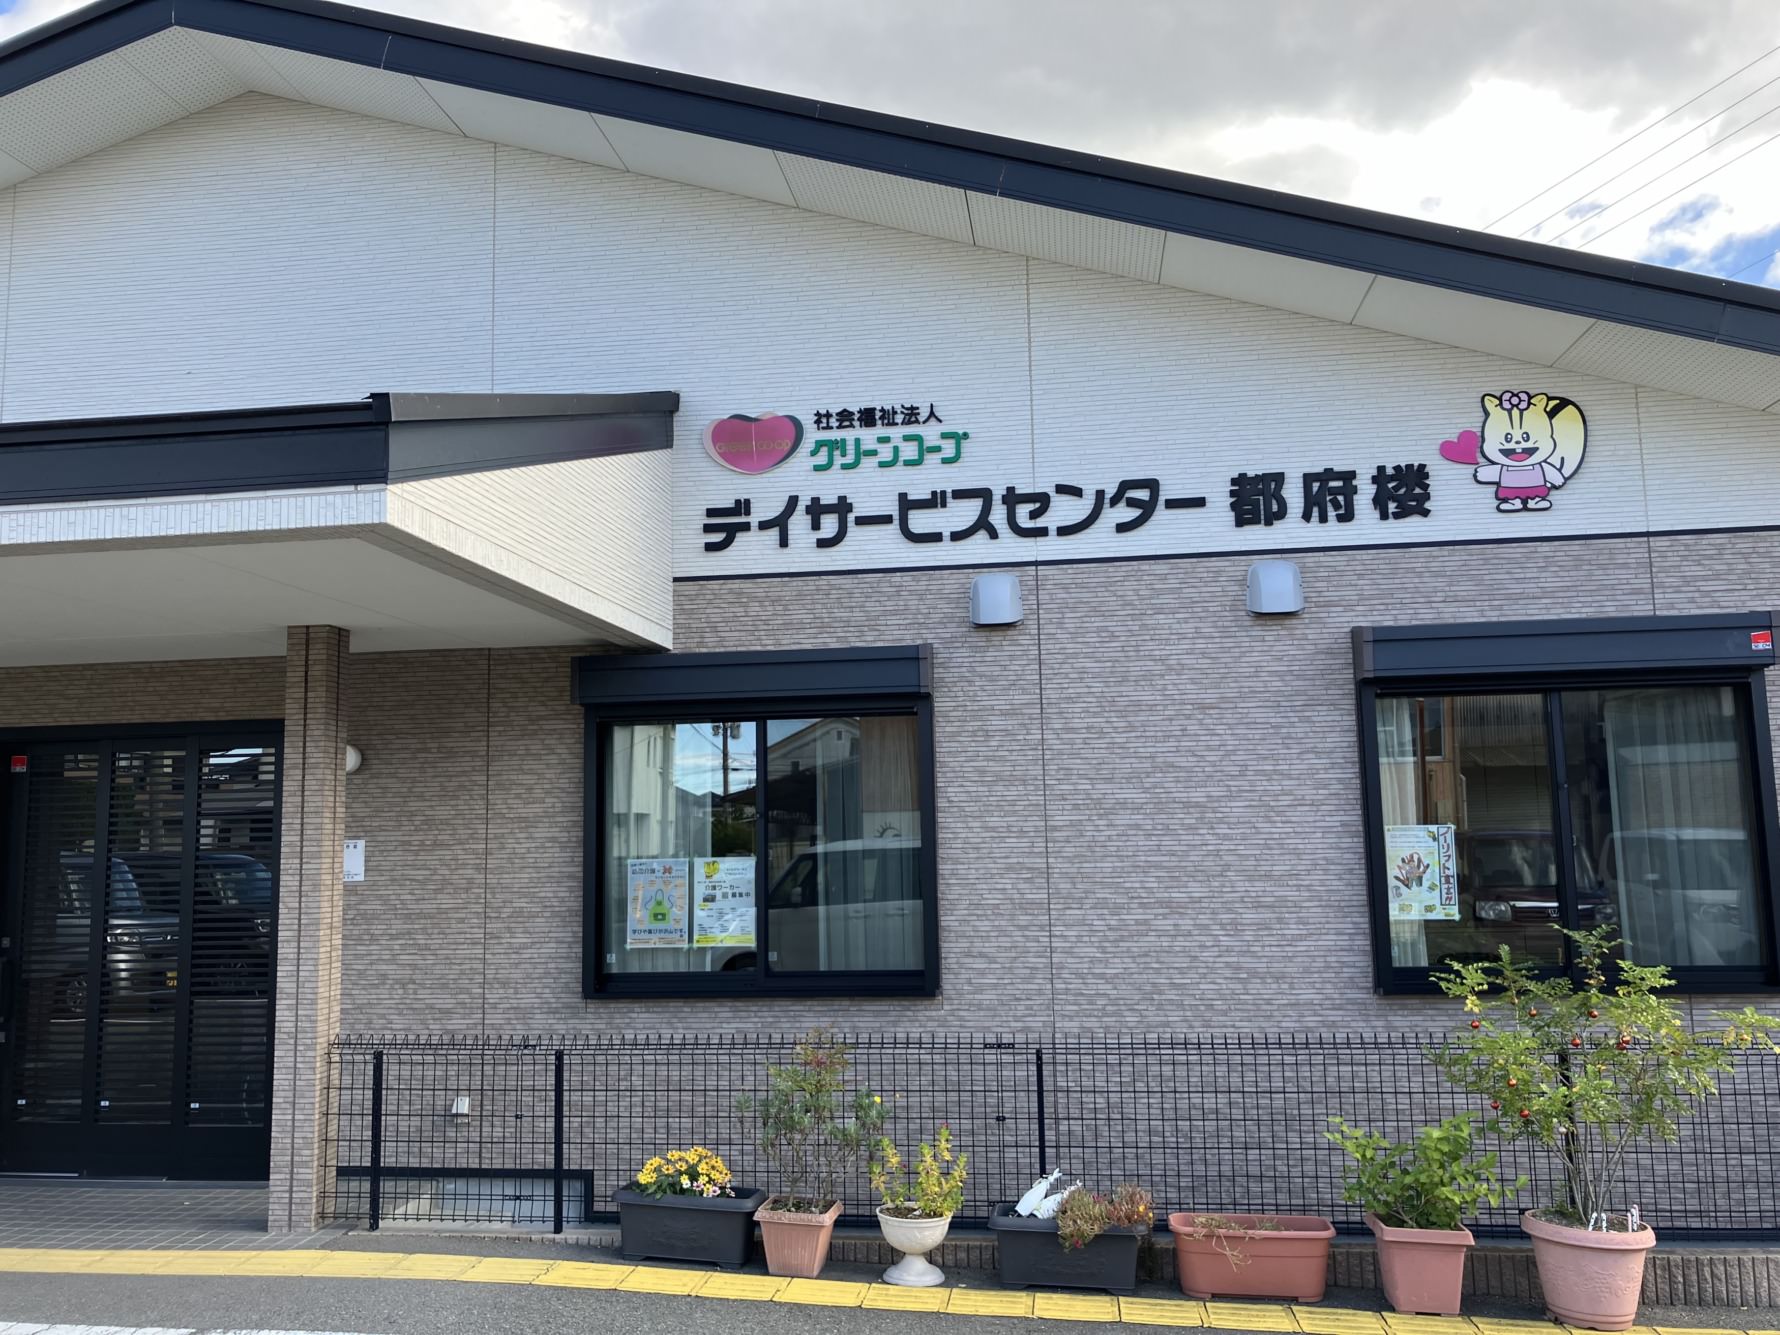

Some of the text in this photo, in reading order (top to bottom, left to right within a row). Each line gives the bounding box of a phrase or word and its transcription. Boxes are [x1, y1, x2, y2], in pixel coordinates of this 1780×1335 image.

[813, 403, 943, 430] 社会福祉法人
[810, 431, 969, 471] グリーンコープ
[703, 463, 1432, 551] デイサービスセンター 都府楼
